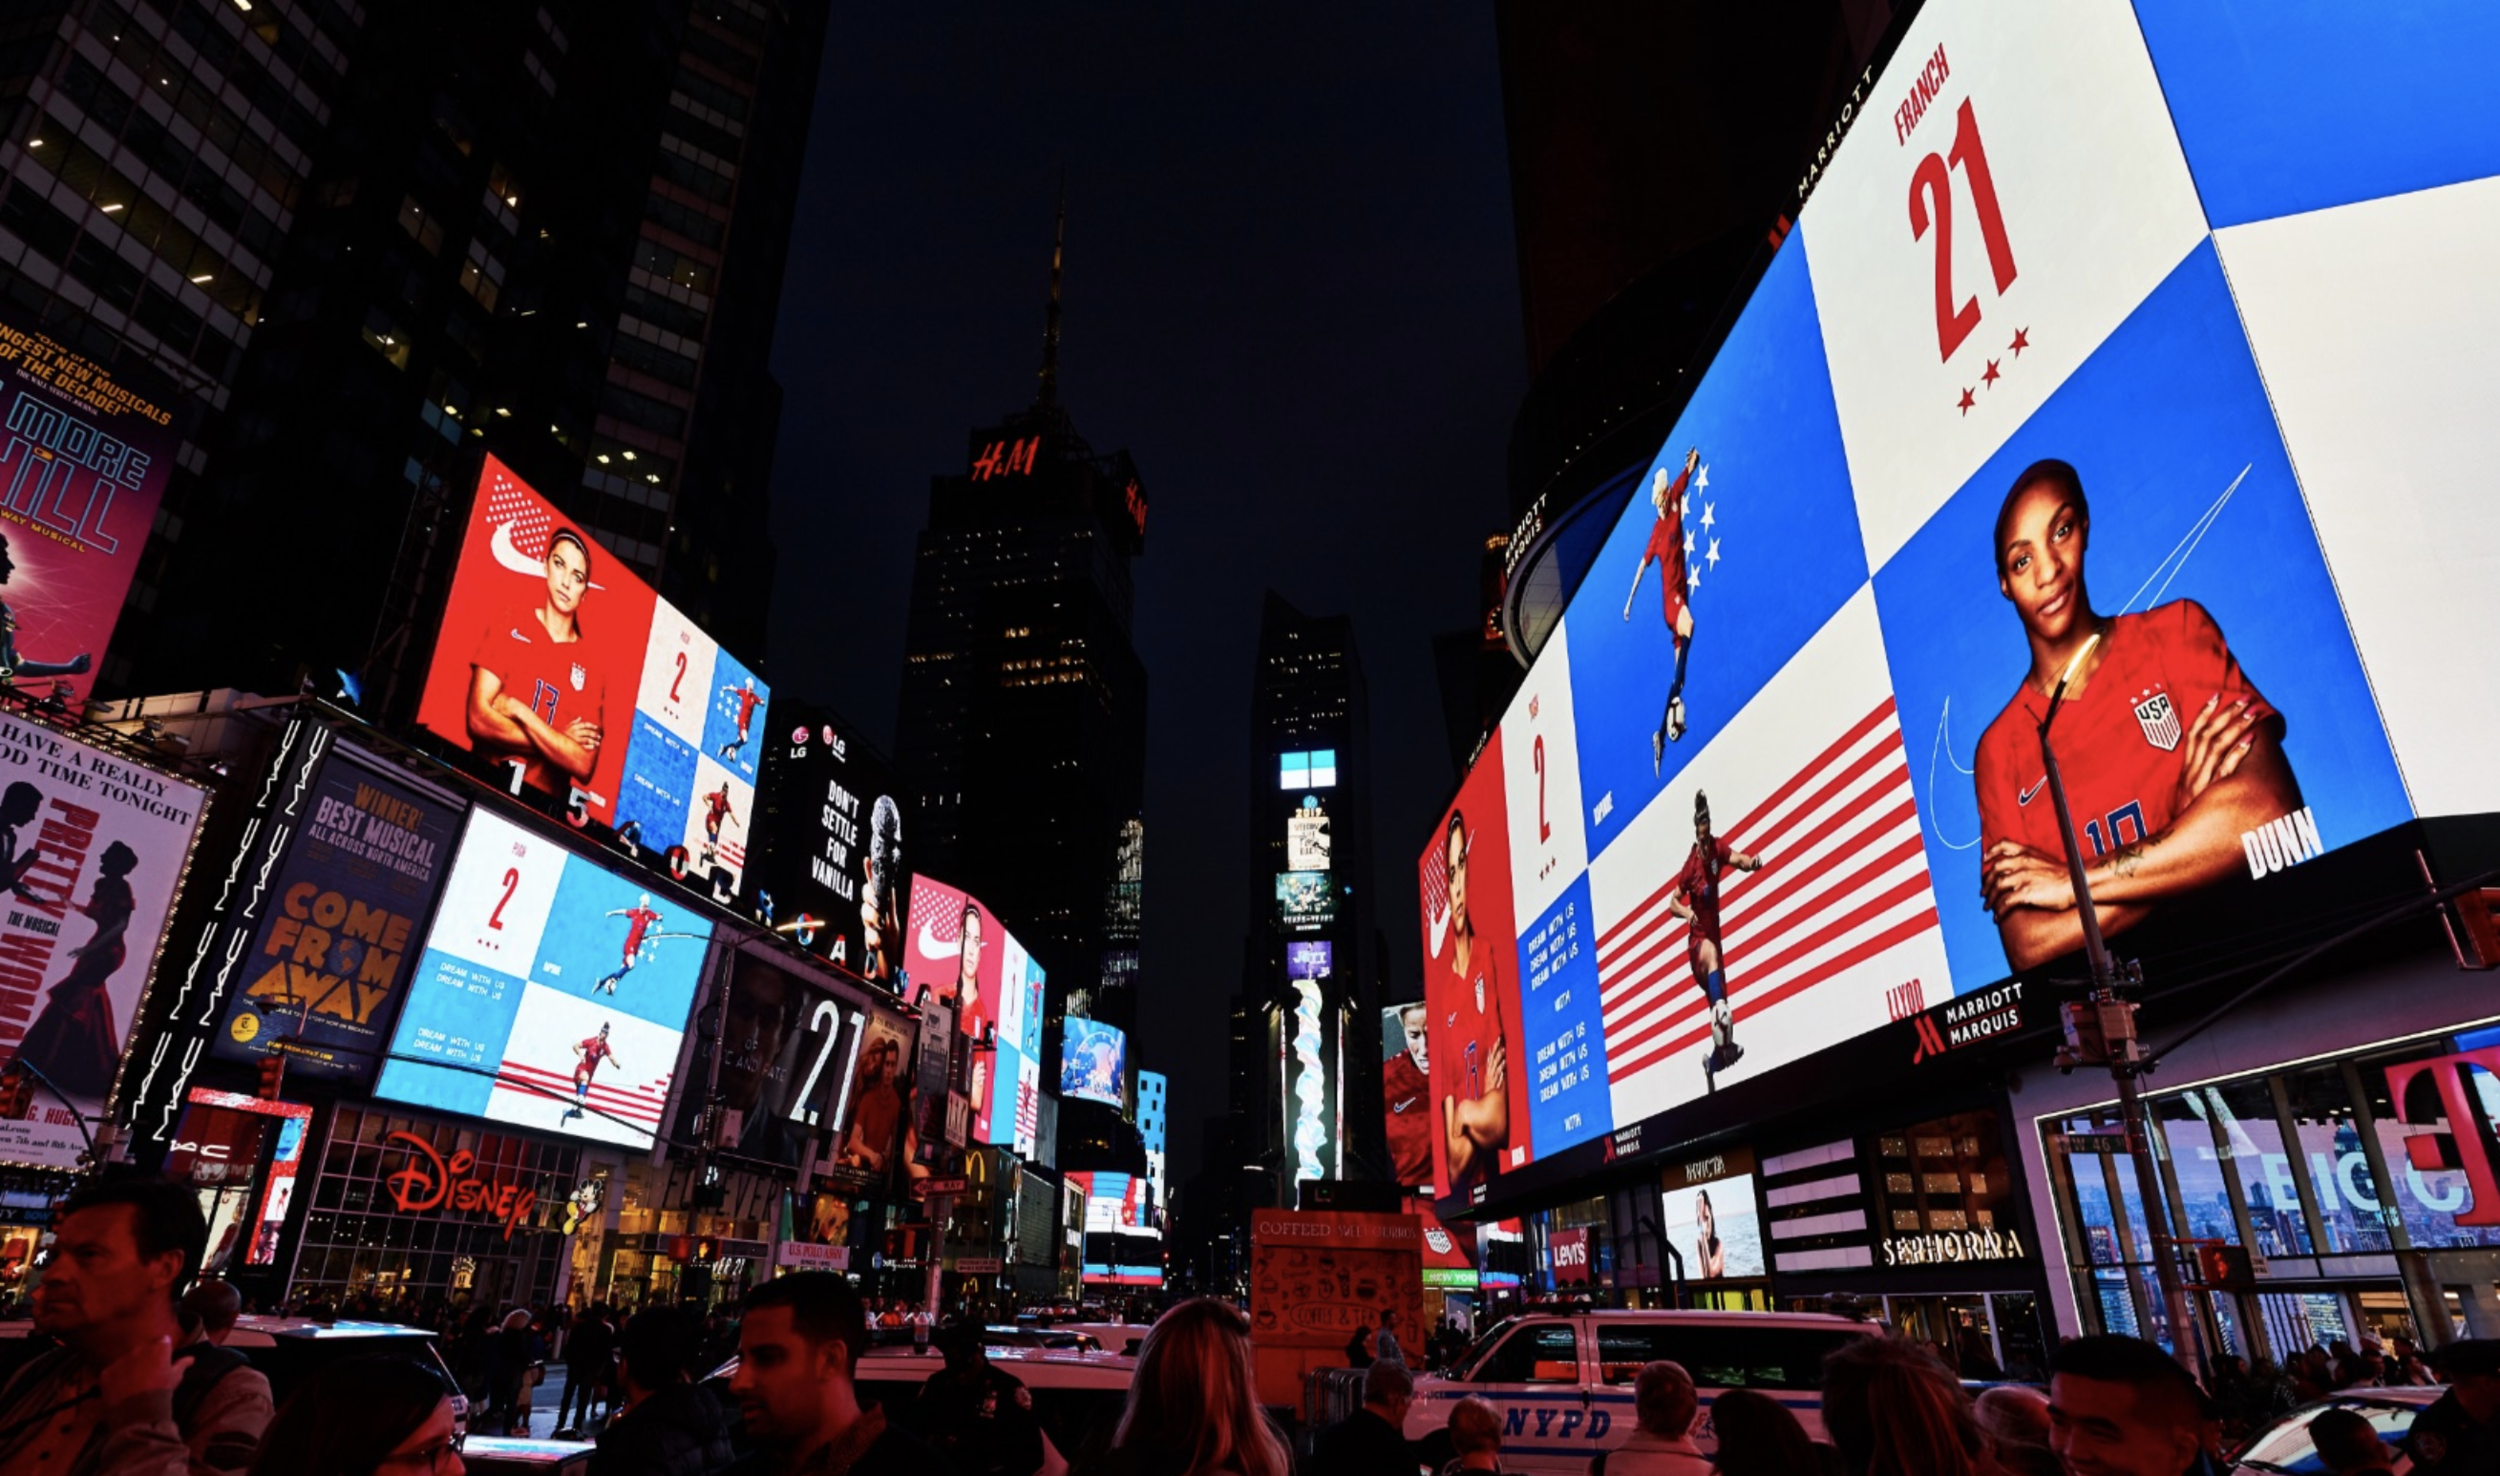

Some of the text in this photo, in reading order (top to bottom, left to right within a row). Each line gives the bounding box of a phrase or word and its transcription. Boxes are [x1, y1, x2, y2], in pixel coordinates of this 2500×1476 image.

[1894, 42, 1950, 147] FRANCH
[1798, 65, 1873, 198] MARRIOTT
[1909, 95, 2018, 364] 21
[0, 342, 22, 362] OF
[21, 354, 56, 380] THE
[54, 354, 93, 385] NEW
[92, 376, 172, 426] MUSICALS
[5, 391, 151, 491] MORE
[971, 435, 1040, 481] H&M
[30, 523, 86, 553] MUSICAL
[669, 650, 687, 706] 2
[2136, 694, 2170, 721] USA
[1, 724, 169, 798] HAVE A REALLY
[790, 747, 807, 759] LG
[832, 734, 846, 755] LG
[37, 758, 93, 790] TIME
[100, 781, 192, 825] TONIGHT
[354, 782, 424, 832] WINNER!
[828, 779, 860, 819] DON'T
[1533, 733, 1551, 845] 2
[315, 795, 366, 836] BEST
[362, 816, 436, 869] MUSICAL
[821, 804, 858, 846] SETTLE
[2241, 805, 2325, 881] DUNN
[308, 823, 327, 842] ALL
[327, 831, 366, 856] ACROSS
[365, 845, 395, 868] NORTH
[393, 858, 431, 883] AMERICA
[826, 837, 847, 868] FOR
[488, 866, 520, 931] 2
[812, 855, 853, 902] VANILLA
[7, 910, 60, 937] THE MUSICAL
[284, 881, 413, 951] COME
[245, 959, 388, 1026] AWAY
[436, 973, 464, 988] DREAM
[467, 983, 488, 996] WITH
[439, 962, 467, 978] DREAM
[471, 972, 491, 986] WITH
[1946, 982, 2023, 1024] MARRIOTT
[418, 1027, 446, 1042] DREAM
[450, 1035, 471, 1049] WITH
[1949, 1008, 2019, 1045] MARQUIS
[413, 1039, 442, 1053] DREAM
[446, 1047, 467, 1059] WITH
[788, 1000, 866, 1133] 21
[2092, 1136, 2111, 1152] 46
[919, 1181, 961, 1192] ONE WAY
[1259, 1221, 1331, 1236] COFFEED
[803, 1246, 824, 1258] POLO
[1503, 1408, 1611, 1438] NYPD
